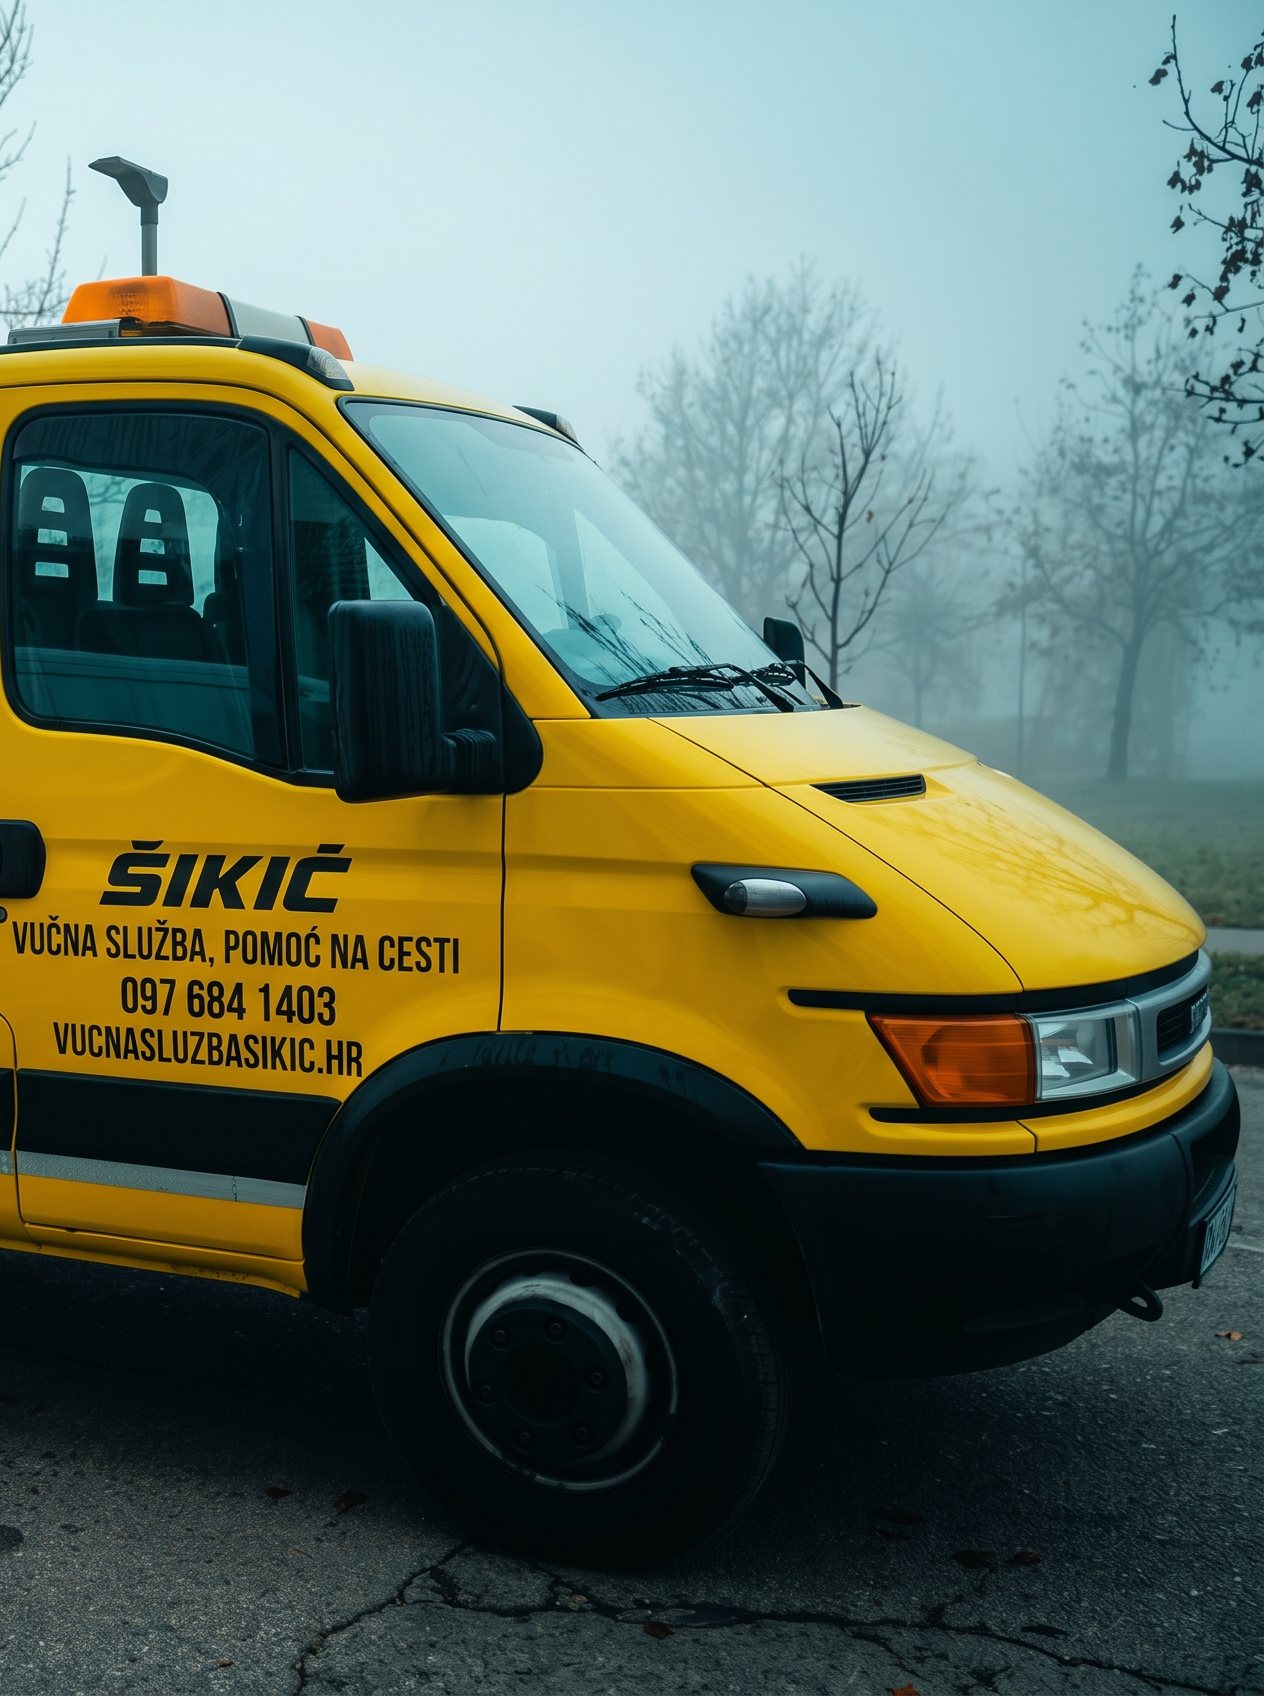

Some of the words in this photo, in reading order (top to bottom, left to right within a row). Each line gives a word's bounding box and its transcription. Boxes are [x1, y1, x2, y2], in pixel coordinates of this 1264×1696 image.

[99, 840, 353, 913] ŠIKIĆ
[12, 915, 98, 959] VUČNA
[106, 919, 214, 968] SLUŽBA,
[224, 925, 321, 969] POMOĆ
[330, 933, 370, 971] NA
[378, 935, 460, 974] CESTI
[121, 976, 177, 1017] 097
[186, 979, 246, 1021] 684
[258, 983, 336, 1026] 1403
[53, 1021, 363, 1078] VUCNASLUZBASIKIC.HR
